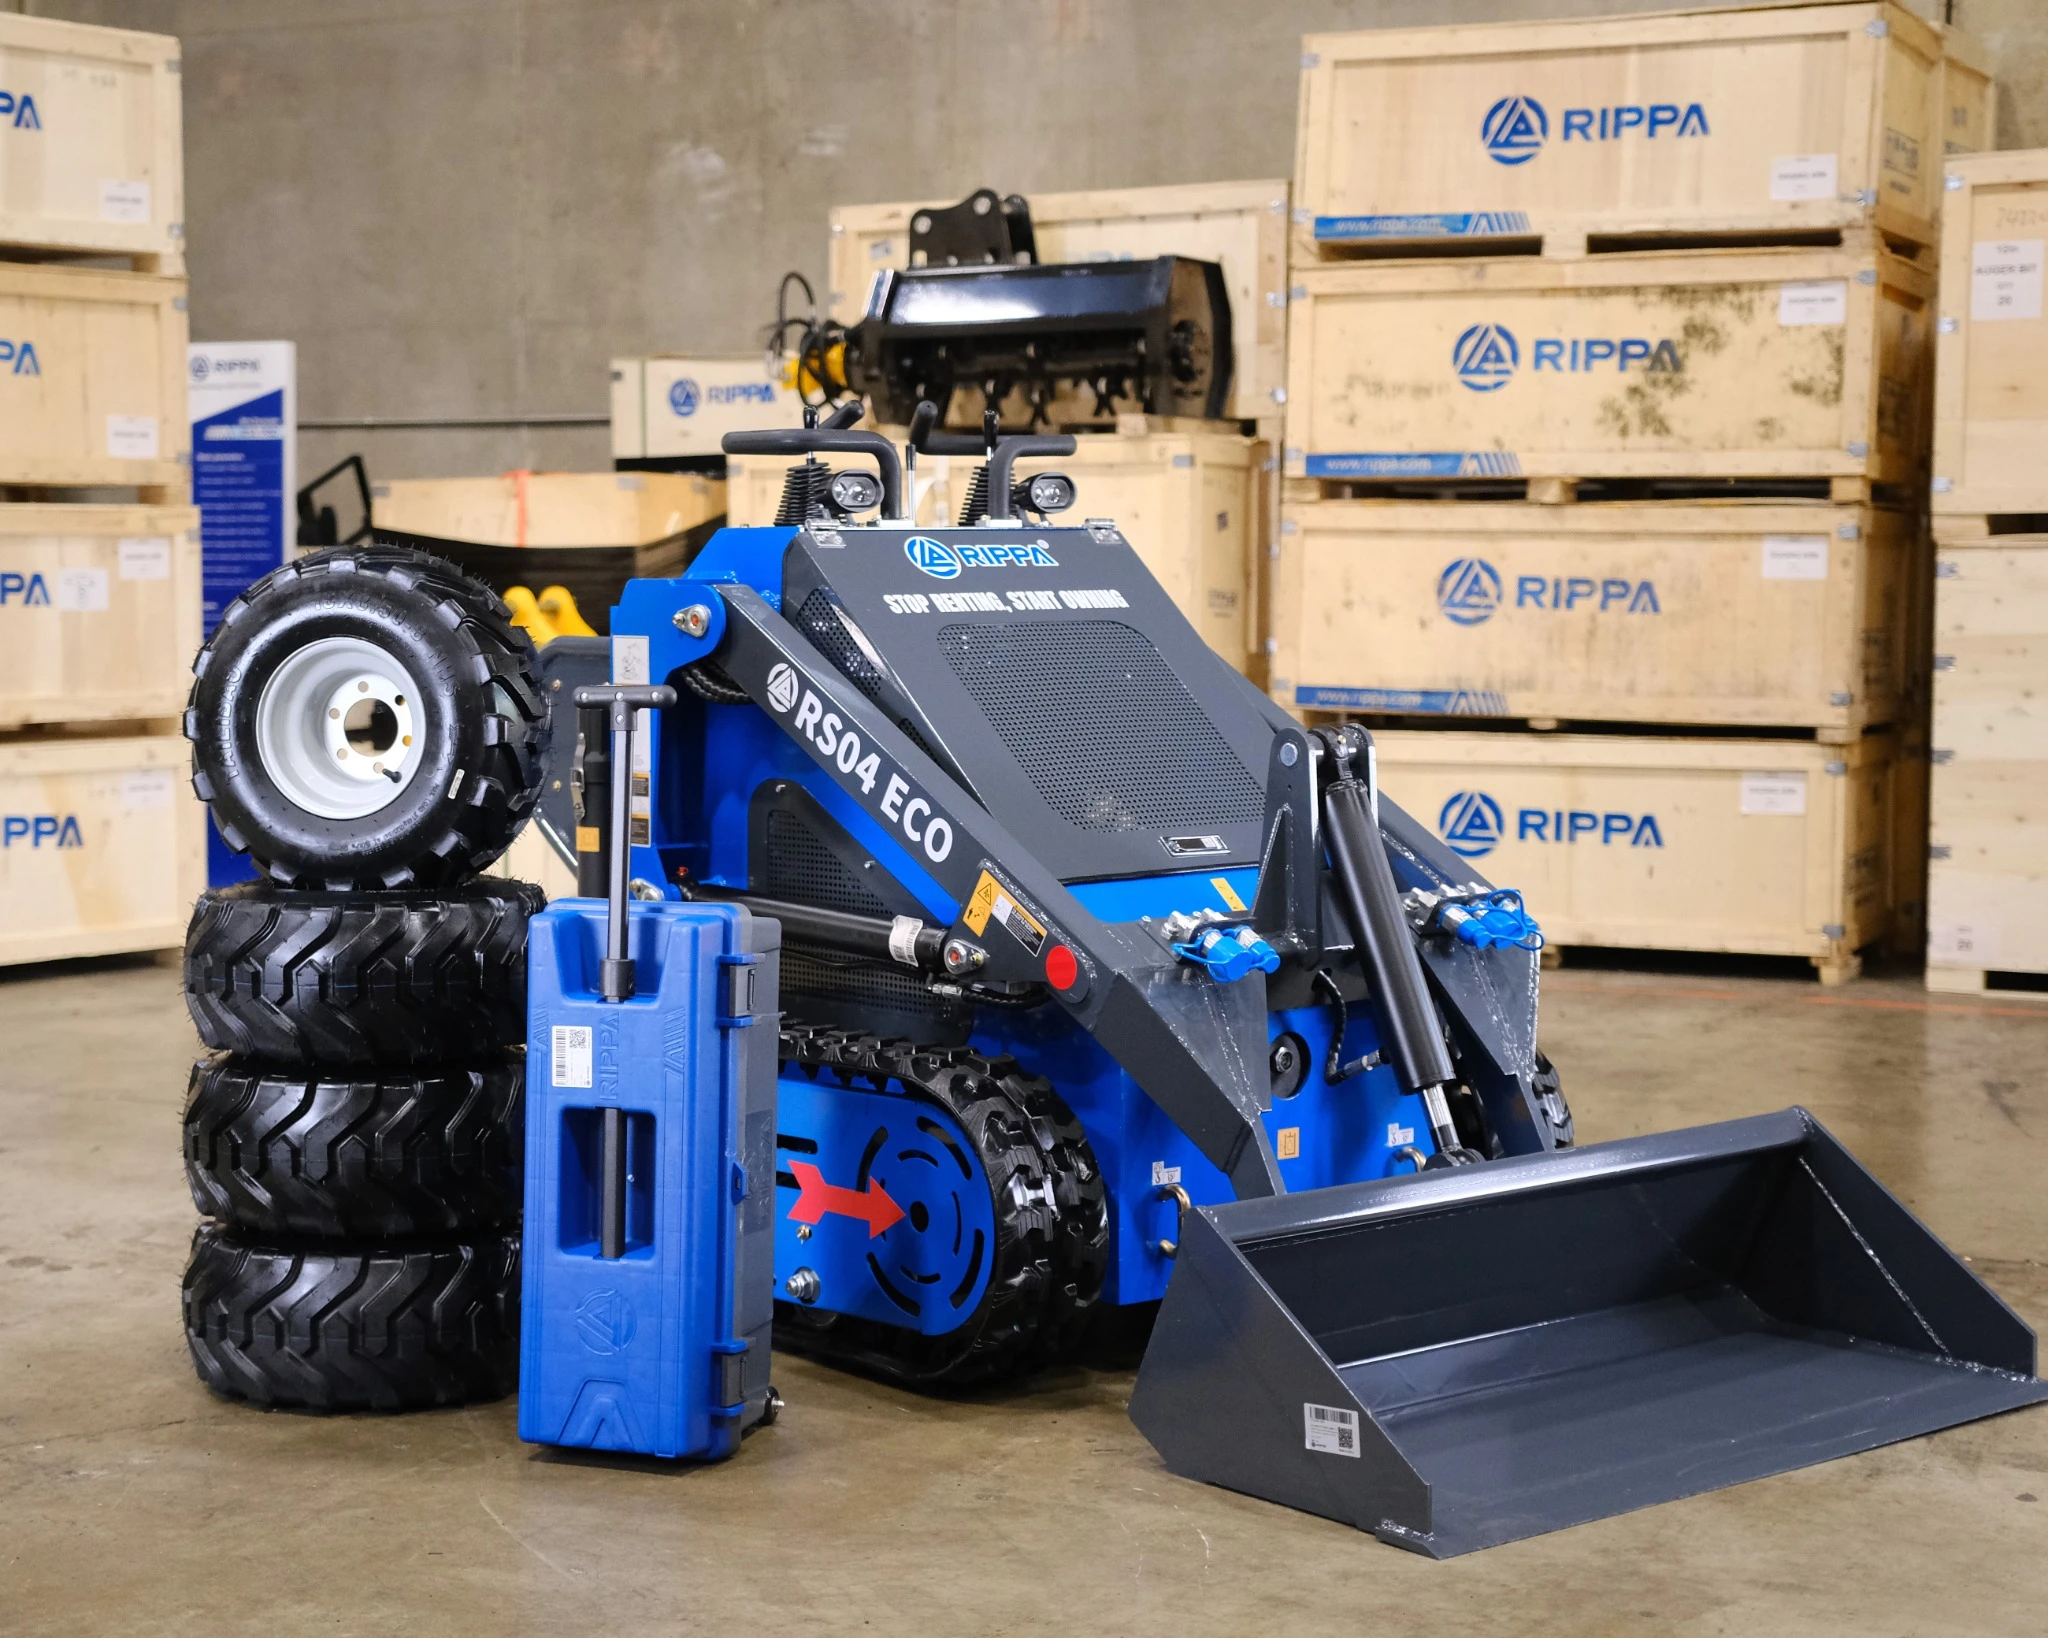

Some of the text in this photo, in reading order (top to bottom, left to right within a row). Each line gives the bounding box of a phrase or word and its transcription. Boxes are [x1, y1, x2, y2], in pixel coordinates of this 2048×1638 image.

[1562, 102, 1710, 142] RIPPA
[1533, 337, 1684, 373] RIPPA
[705, 384, 776, 403] RIPPA
[953, 544, 1059, 566] RIPPA
[883, 588, 1130, 614] STOP RENTING, START OWNING
[1516, 576, 1661, 613] RIPPA
[794, 689, 953, 863] RS04 ECO
[1518, 808, 1665, 848] RIPPA
[598, 1011, 619, 1101] RIPPA
